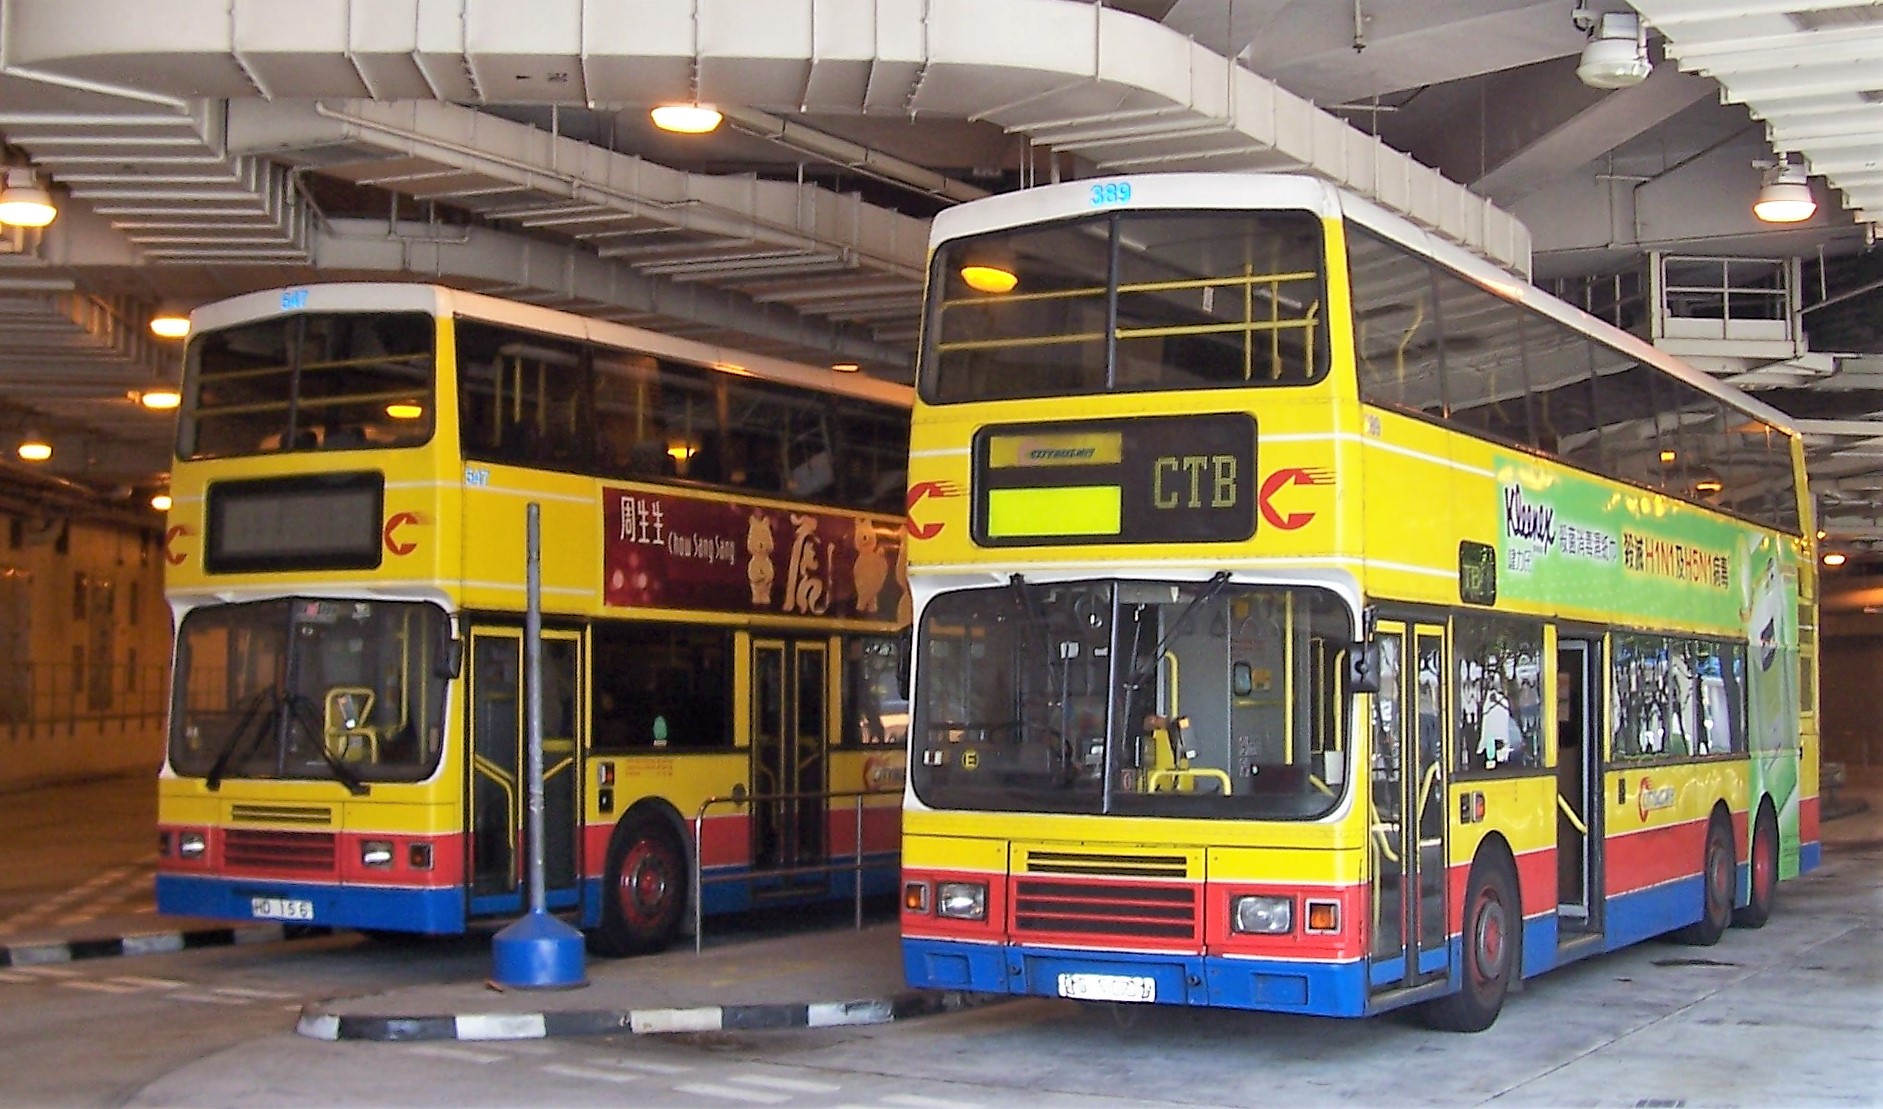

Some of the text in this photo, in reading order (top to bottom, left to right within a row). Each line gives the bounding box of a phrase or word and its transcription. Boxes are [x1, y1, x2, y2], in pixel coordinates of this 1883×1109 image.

[1090, 183, 1131, 206] 389
[1154, 455, 1237, 509] CTB
[620, 496, 664, 545] 周生生
[1504, 483, 1557, 555] Kleenex
[668, 530, 735, 566] Chow Sang Sang
